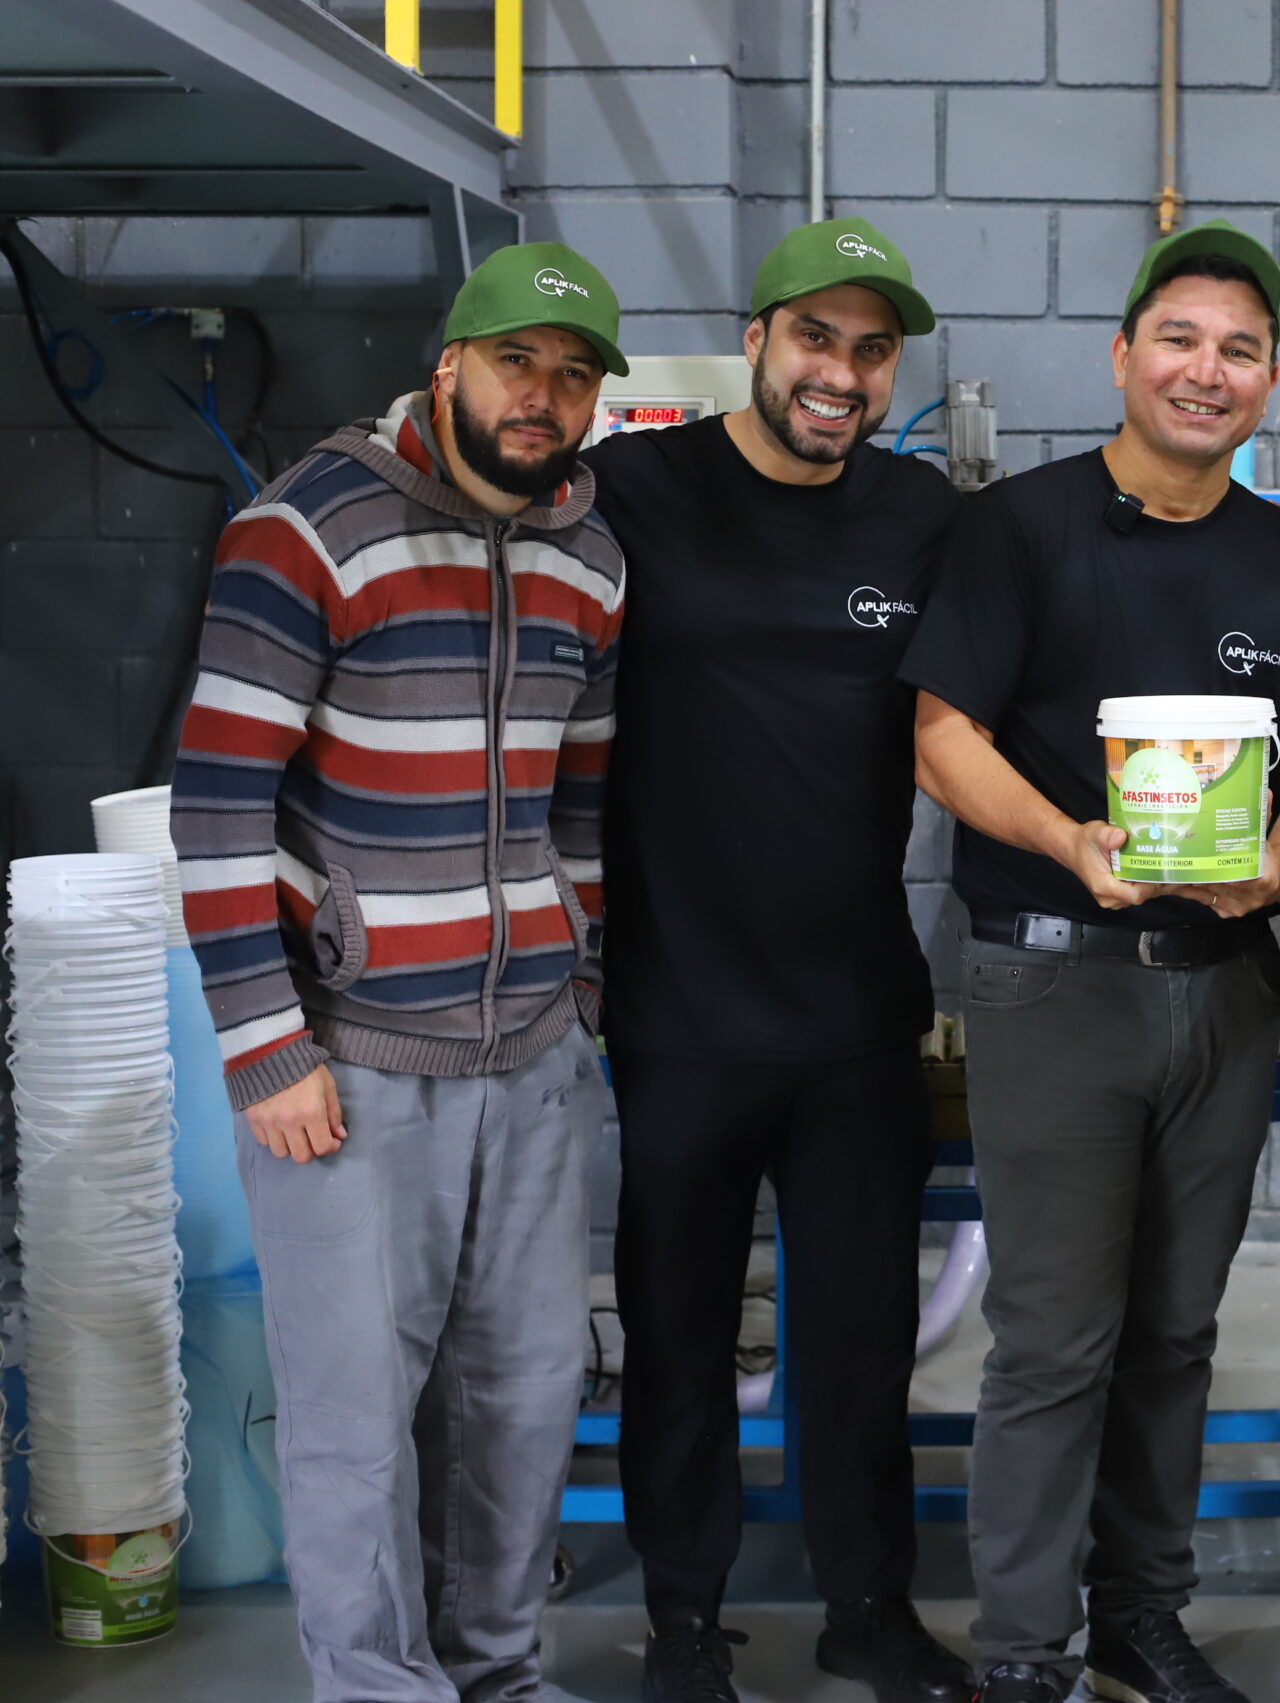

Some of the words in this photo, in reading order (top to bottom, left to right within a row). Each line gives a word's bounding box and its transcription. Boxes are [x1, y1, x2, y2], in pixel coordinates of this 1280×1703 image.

[541, 276, 569, 289] APLIK
[856, 601, 892, 613] APLIK
[892, 599, 918, 614] FÁCIL
[1226, 645, 1259, 661] APLIK
[1121, 791, 1198, 804] AFASTINSETOS
[1136, 845, 1154, 853] BASE
[1155, 843, 1178, 854] ÁGUA
[1130, 858, 1157, 866] EXTERIOR
